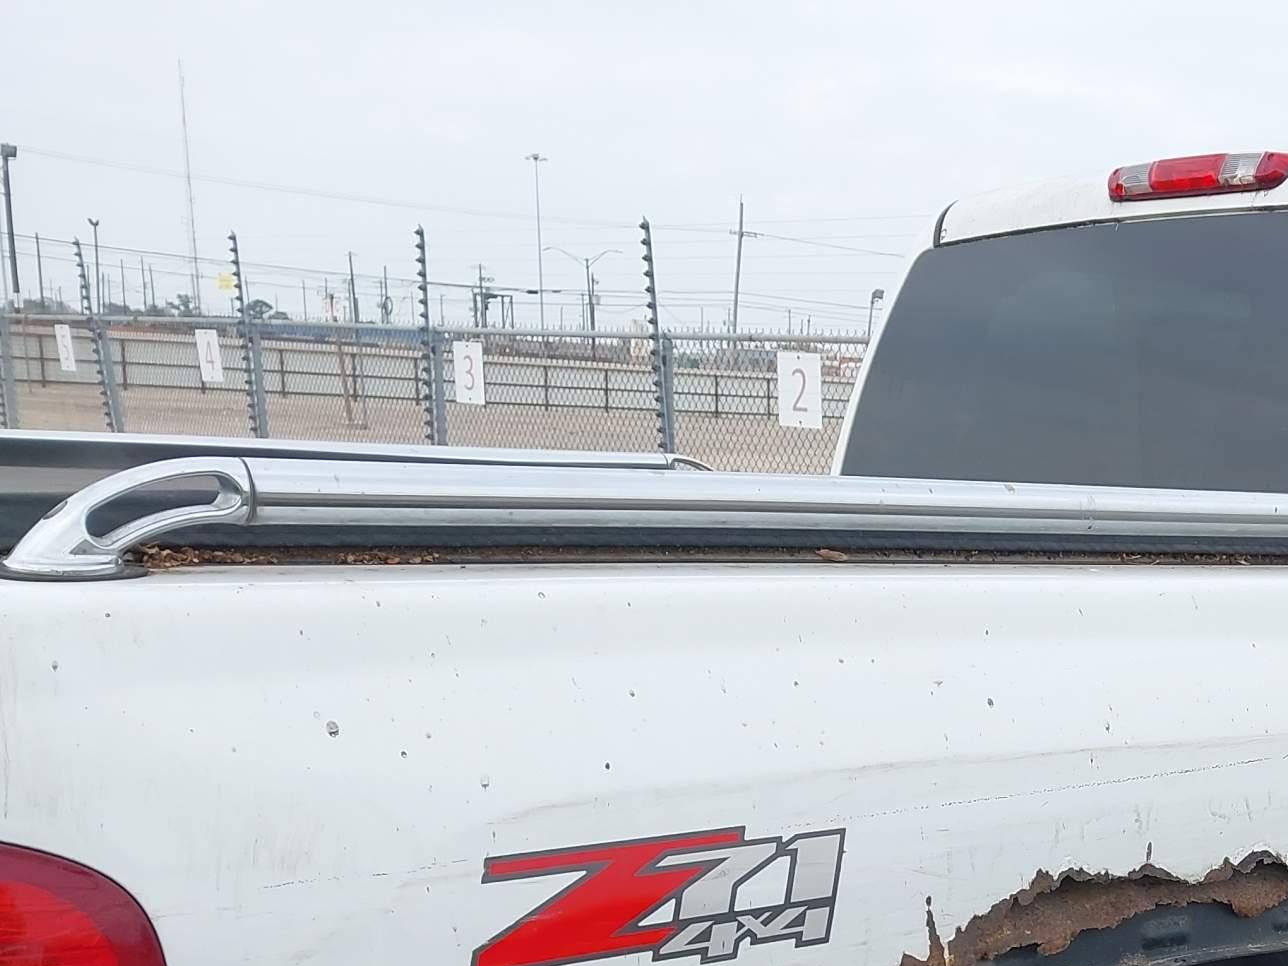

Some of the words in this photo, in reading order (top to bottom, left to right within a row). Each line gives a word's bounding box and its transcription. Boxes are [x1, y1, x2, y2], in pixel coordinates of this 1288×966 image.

[205, 339, 215, 369] 4
[464, 355, 475, 391] 3
[791, 367, 808, 412] 2
